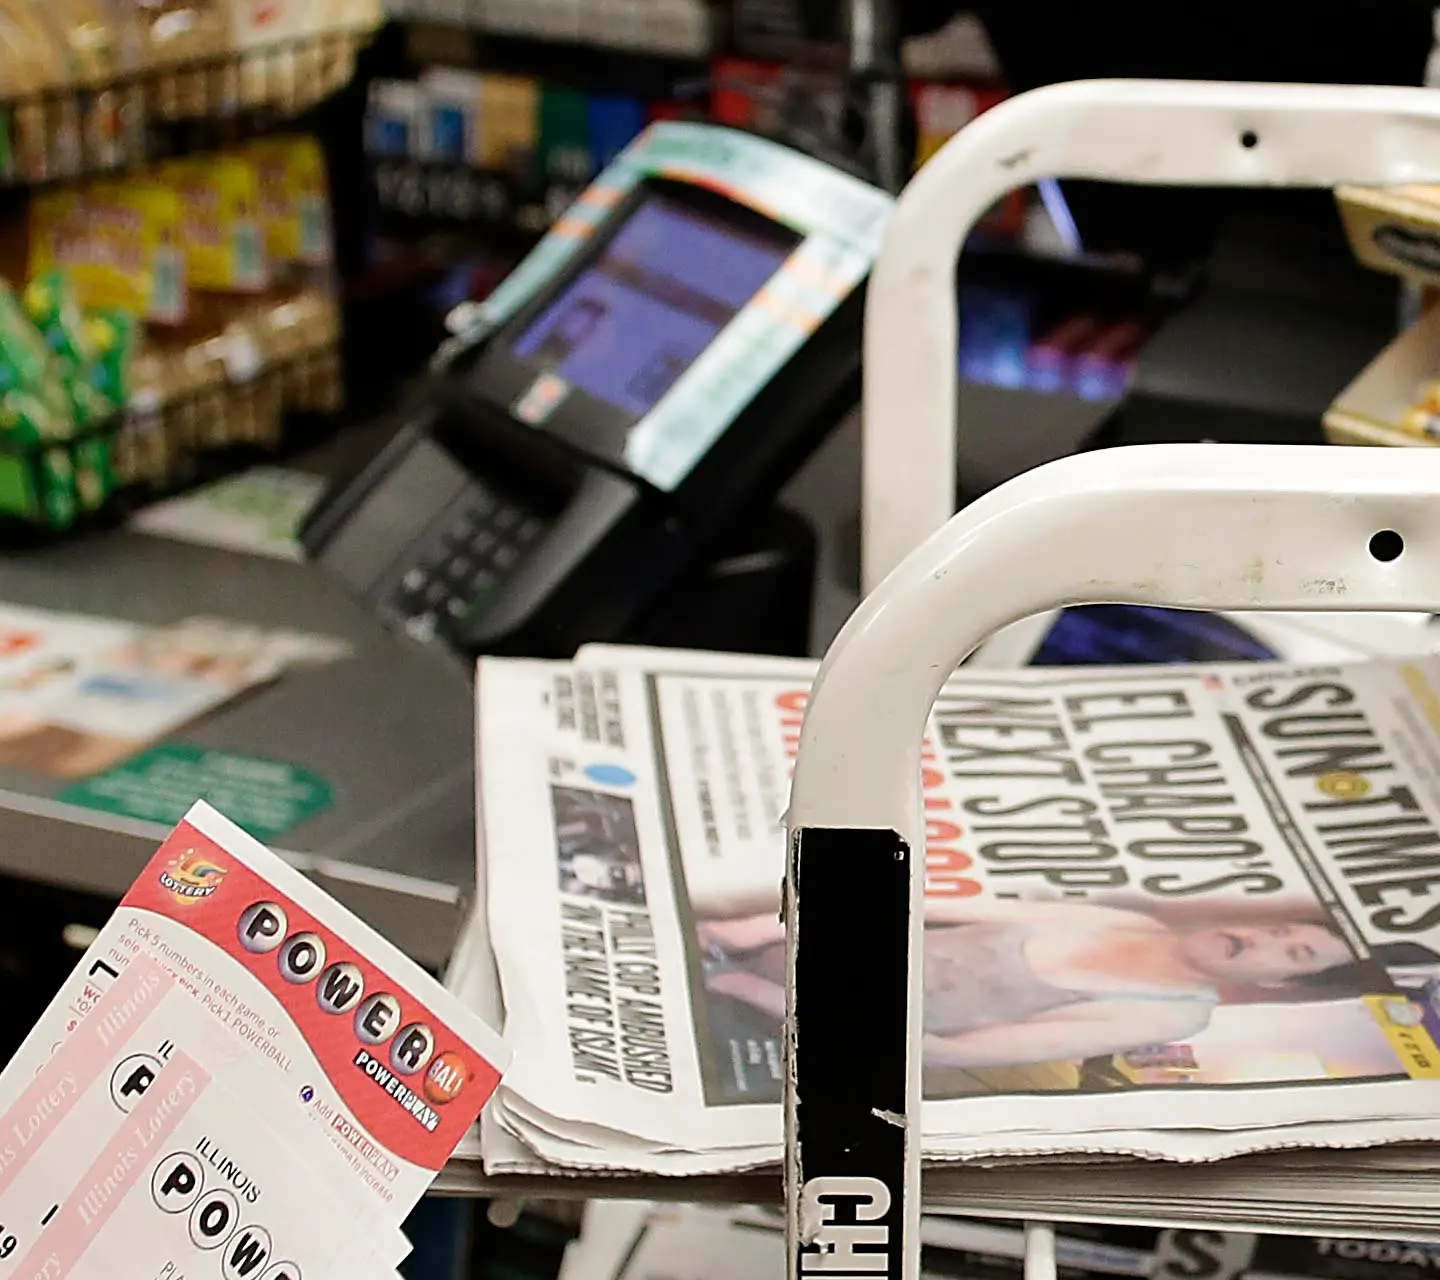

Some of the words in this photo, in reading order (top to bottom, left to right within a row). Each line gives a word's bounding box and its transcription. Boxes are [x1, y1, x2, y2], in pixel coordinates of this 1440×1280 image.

[938, 692, 1080, 786] NEXT
[1064, 689, 1189, 738] EL
[1082, 738, 1285, 899] CHAPO'S
[129, 918, 151, 941] Pick
[159, 943, 203, 979] numbers
[203, 975, 214, 988] in
[214, 985, 238, 1007] each
[267, 1027, 278, 1038] or
[201, 994, 222, 1017] Pick
[231, 1018, 291, 1072] POWERBALL
[12, 1066, 78, 1144] Lottery
[313, 1099, 333, 1119] Add
[77, 1151, 138, 1222] Illinois
[139, 1069, 198, 1148] Lottery
[194, 1134, 262, 1204] ILLINOIS
